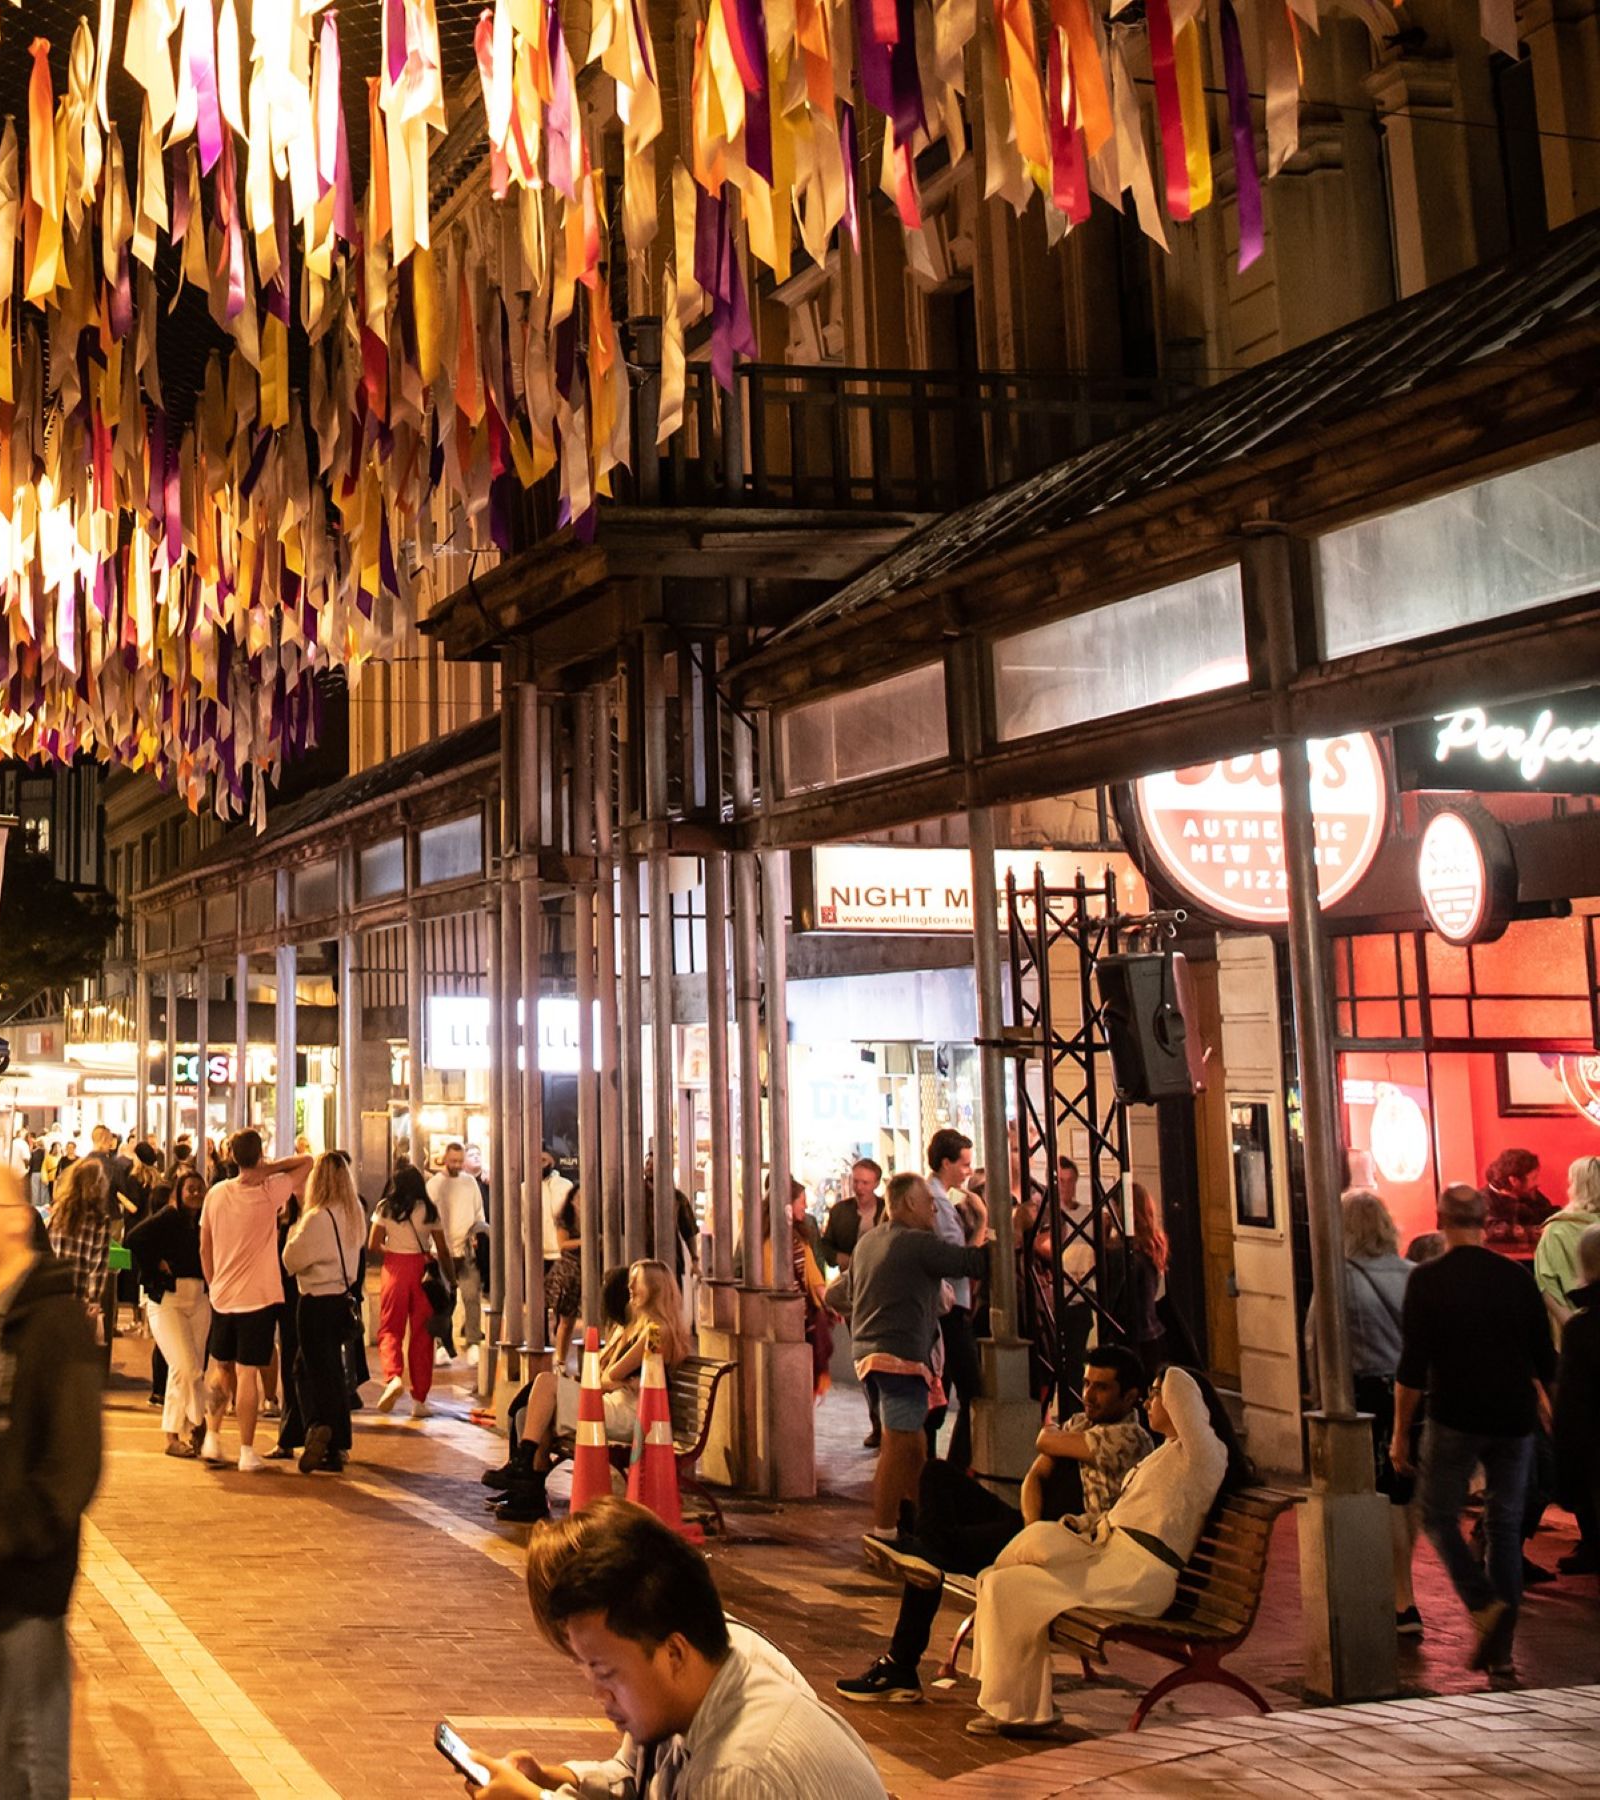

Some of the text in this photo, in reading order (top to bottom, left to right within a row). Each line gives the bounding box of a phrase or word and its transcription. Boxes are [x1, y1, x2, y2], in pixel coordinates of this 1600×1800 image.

[1433, 707, 1600, 781] Perfec
[1183, 819, 1347, 842] AUTHEIC
[1191, 844, 1342, 866] NEW YRK
[1224, 870, 1288, 890] PIZZ
[830, 886, 932, 907] NIGHT
